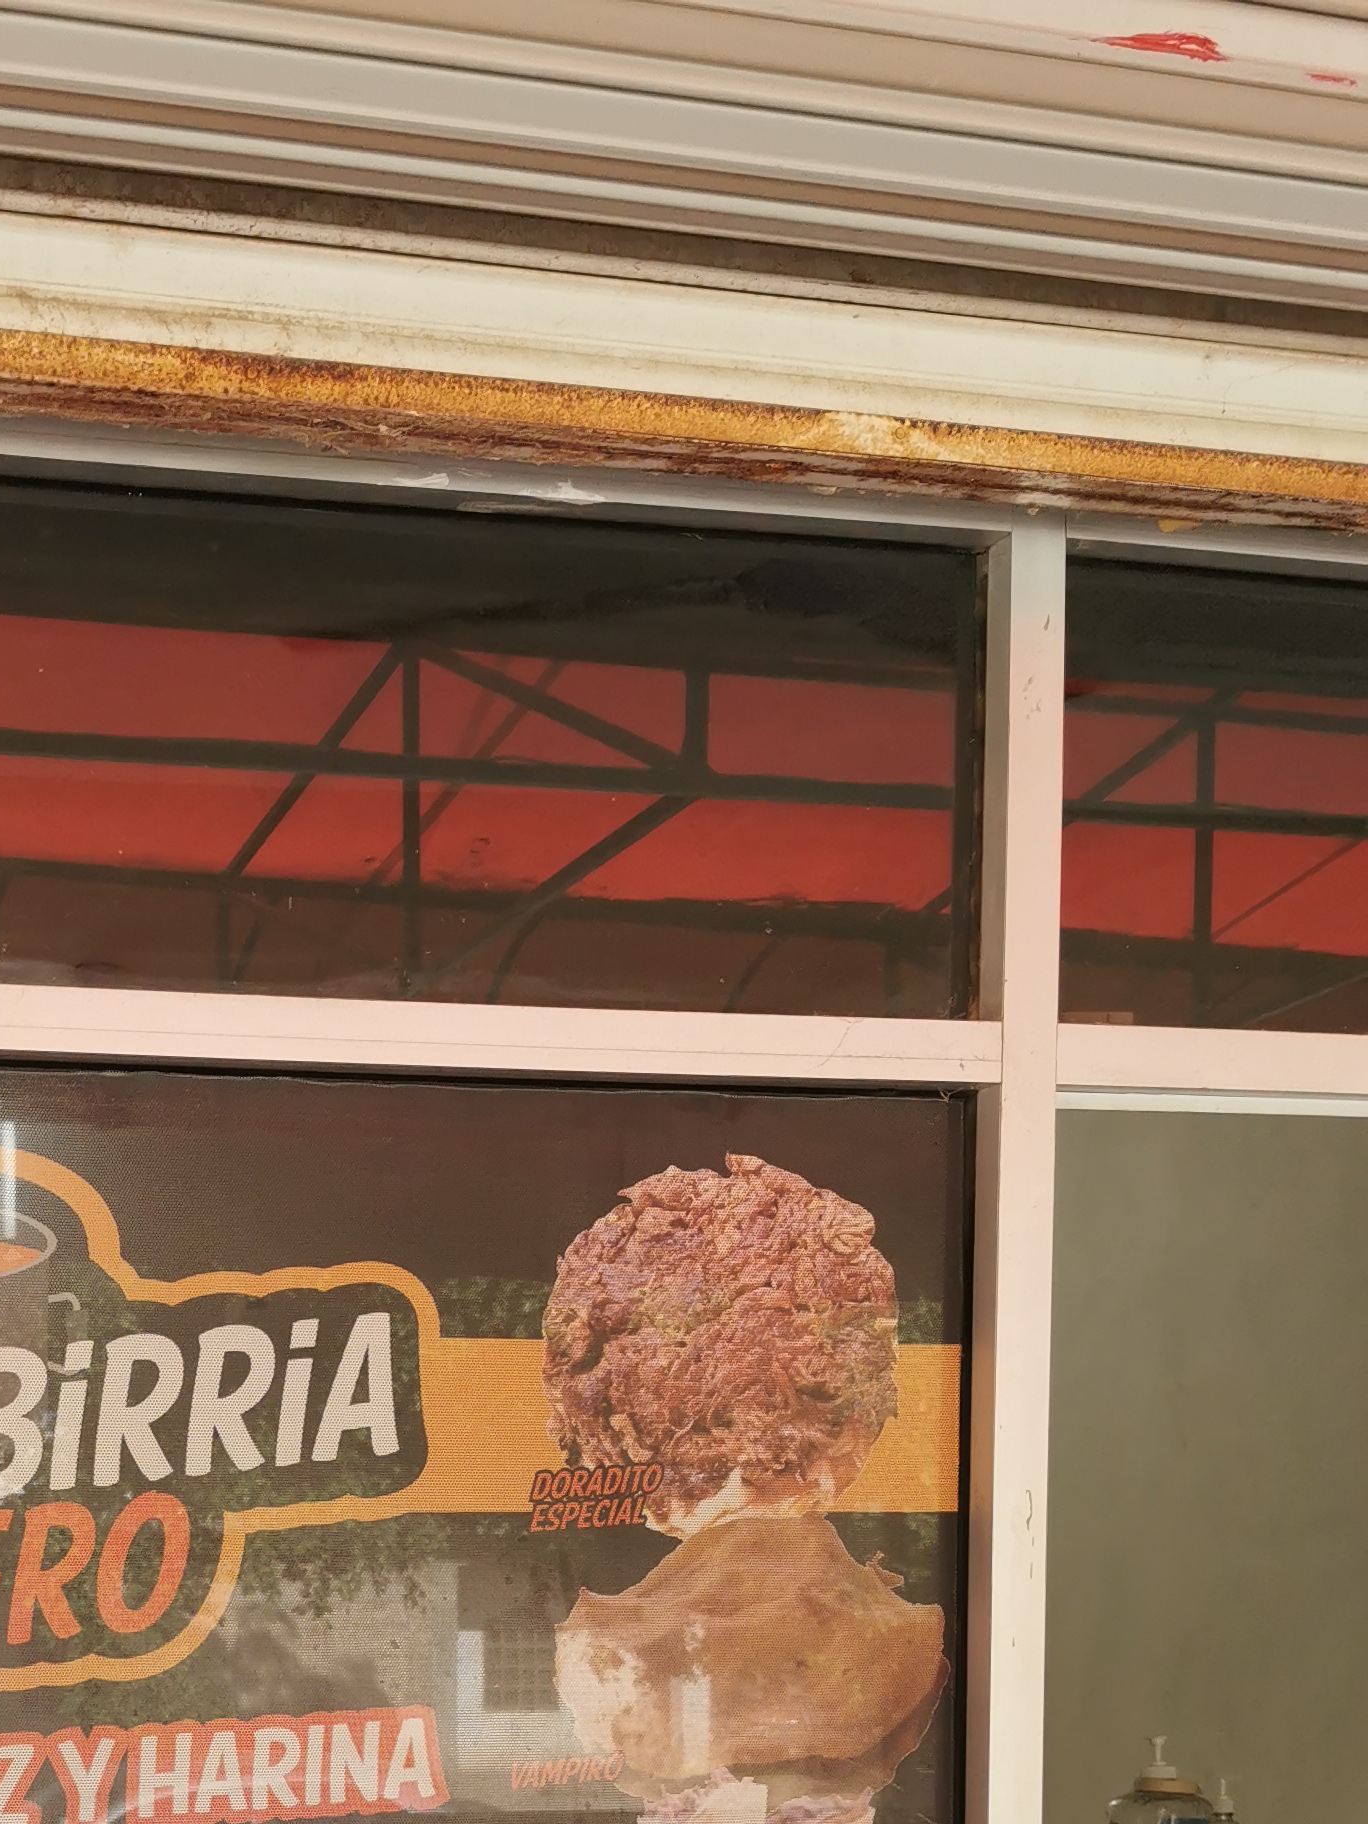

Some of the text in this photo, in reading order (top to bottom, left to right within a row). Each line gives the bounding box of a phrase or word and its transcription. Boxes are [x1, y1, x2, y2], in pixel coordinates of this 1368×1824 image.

[532, 1463, 664, 1501] DORADITO
[530, 1497, 646, 1533] ESPECIAL
[58, 1737, 115, 1823] Y
[138, 1718, 436, 1818] HARINA
[510, 1751, 624, 1791] VAMPIRO
